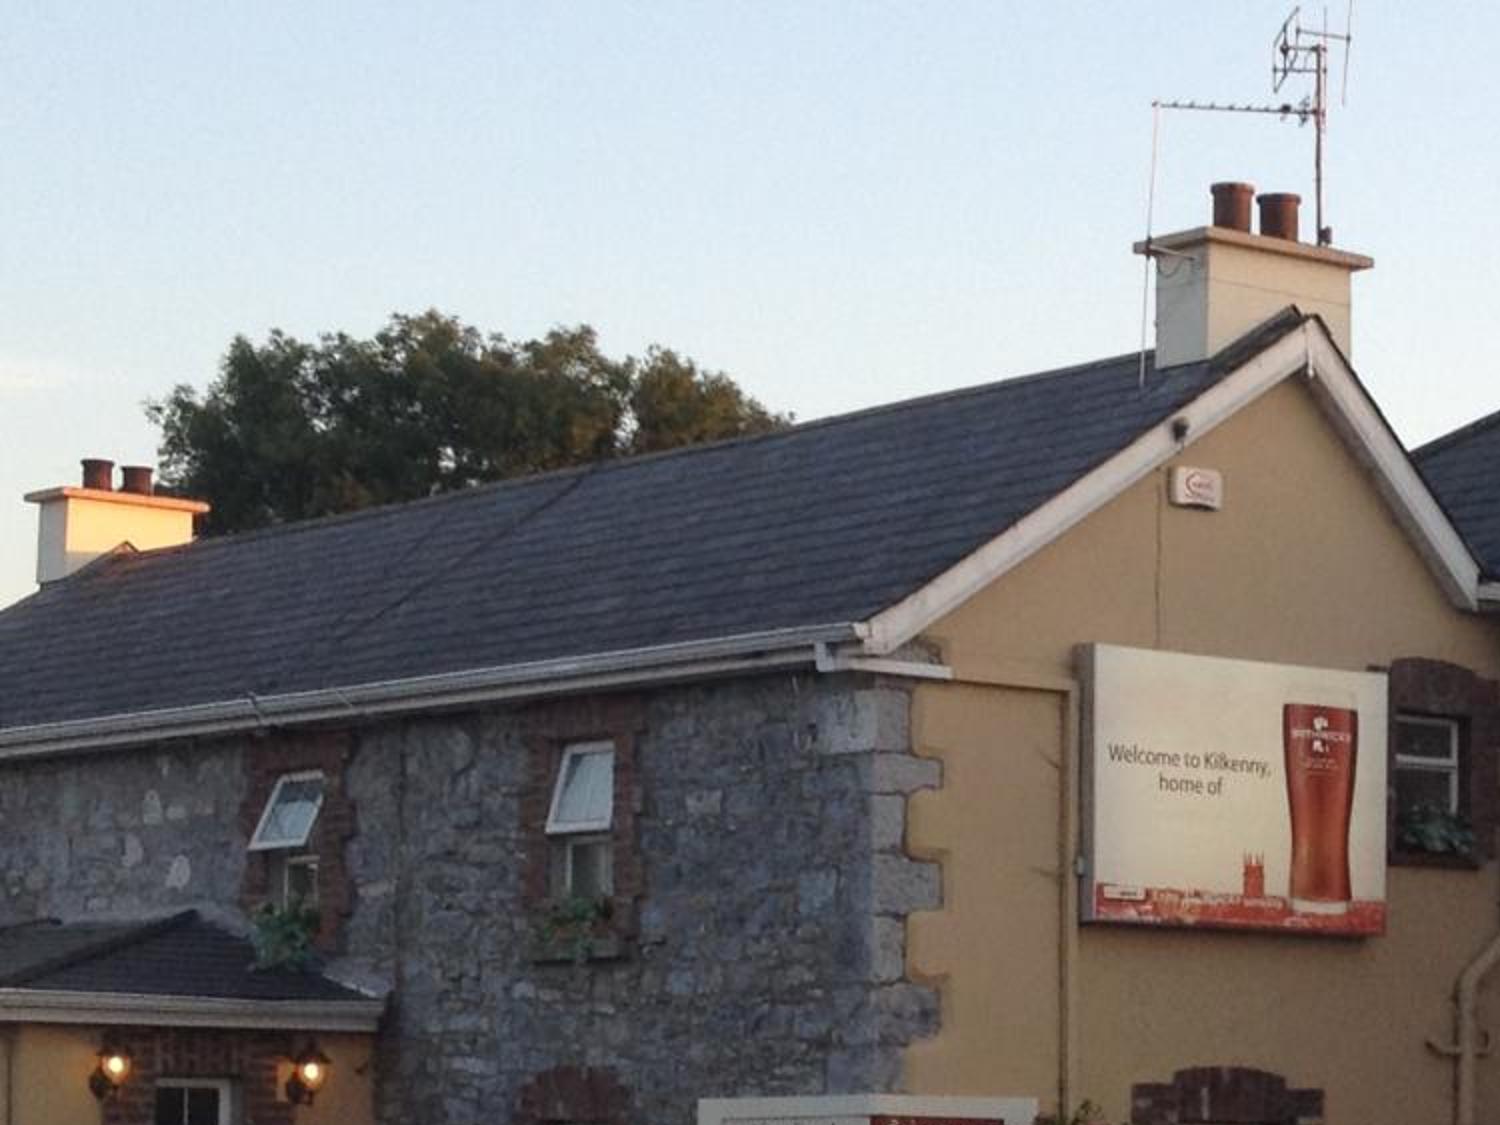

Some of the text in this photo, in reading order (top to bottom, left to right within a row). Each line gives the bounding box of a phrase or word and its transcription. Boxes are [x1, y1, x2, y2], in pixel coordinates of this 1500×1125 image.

[1108, 743, 1181, 768] Welcome
[1184, 752, 1200, 769] to
[1203, 751, 1272, 779] Kilkenny,
[1159, 771, 1223, 796] home of
